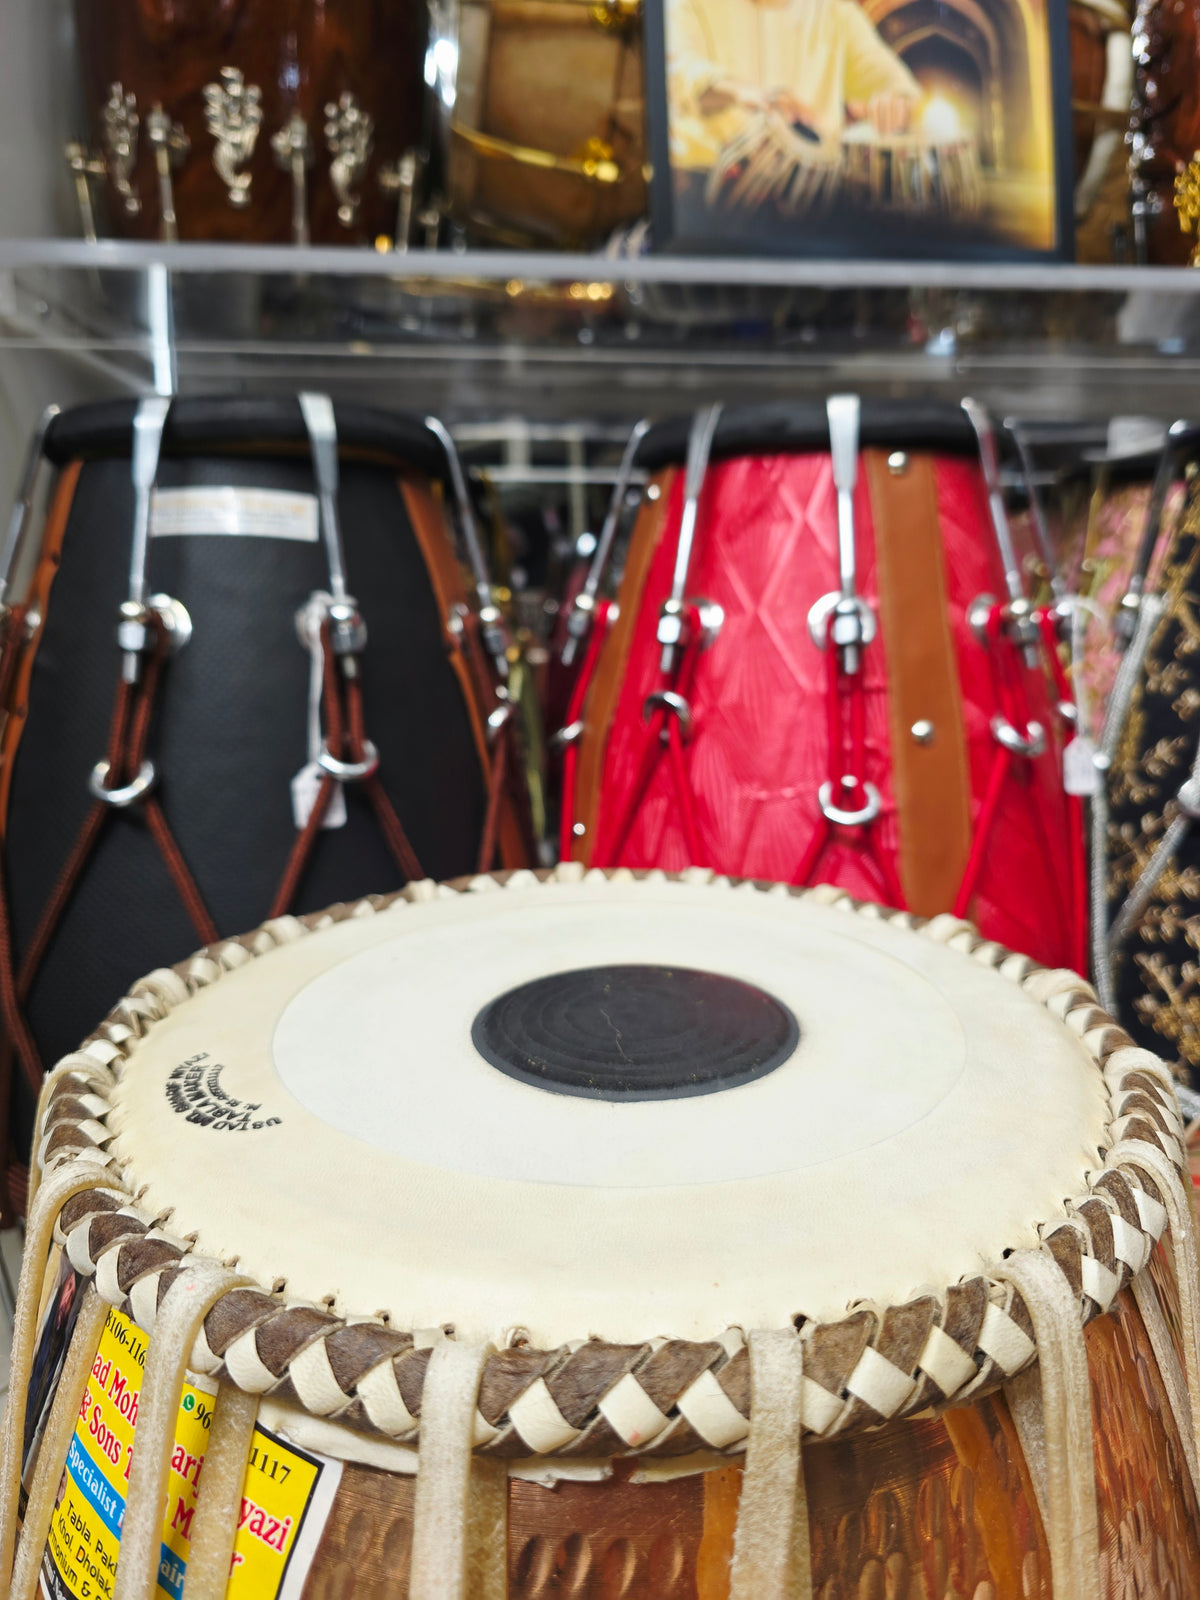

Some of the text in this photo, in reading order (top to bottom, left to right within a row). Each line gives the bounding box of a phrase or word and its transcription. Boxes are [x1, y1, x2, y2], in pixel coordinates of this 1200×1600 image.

[183, 1064, 252, 1121] TABLA MAKER
[212, 1116, 283, 1131] USTAD
[91, 1355, 112, 1389] ad
[105, 1310, 147, 1369] 8106-116
[250, 1447, 291, 1484] 1117
[89, 1405, 121, 1464] Sons
[51, 1527, 78, 1587] rmonium
[81, 1580, 91, 1597] &
